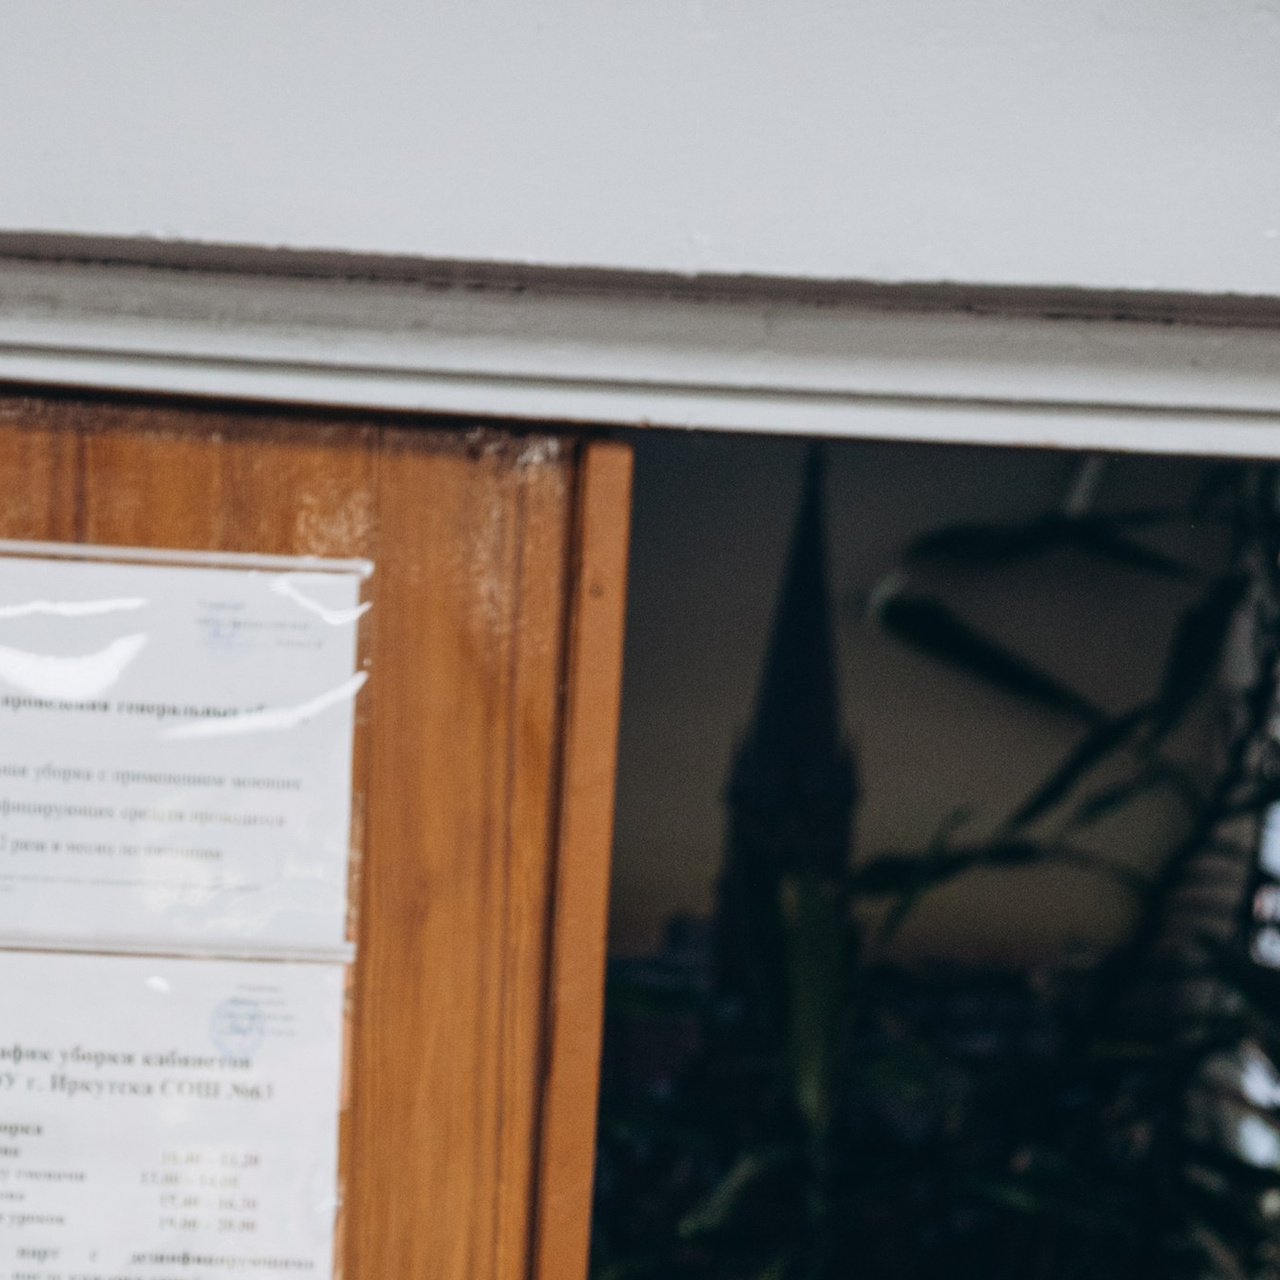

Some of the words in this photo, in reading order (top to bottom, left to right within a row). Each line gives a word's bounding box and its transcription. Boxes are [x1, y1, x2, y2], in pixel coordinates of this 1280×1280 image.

[0, 694, 108, 716] проведения
[34, 763, 92, 783] уборка
[112, 770, 224, 790] применением
[121, 807, 184, 826] средств
[190, 811, 285, 832] проводится
[10, 837, 46, 854] раза
[66, 841, 114, 858] месяц
[57, 1045, 135, 1071] уборки
[141, 1048, 250, 1071] кабинетов
[26, 1075, 43, 1092] г.
[50, 1074, 153, 1102] Иркутска
[159, 1079, 221, 1100] СОШ
[14, 1166, 87, 1183] сменами
[9, 1211, 66, 1230] уроков
[16, 1245, 60, 1264] парт
[130, 1247, 314, 1276] дезинфицирующими
